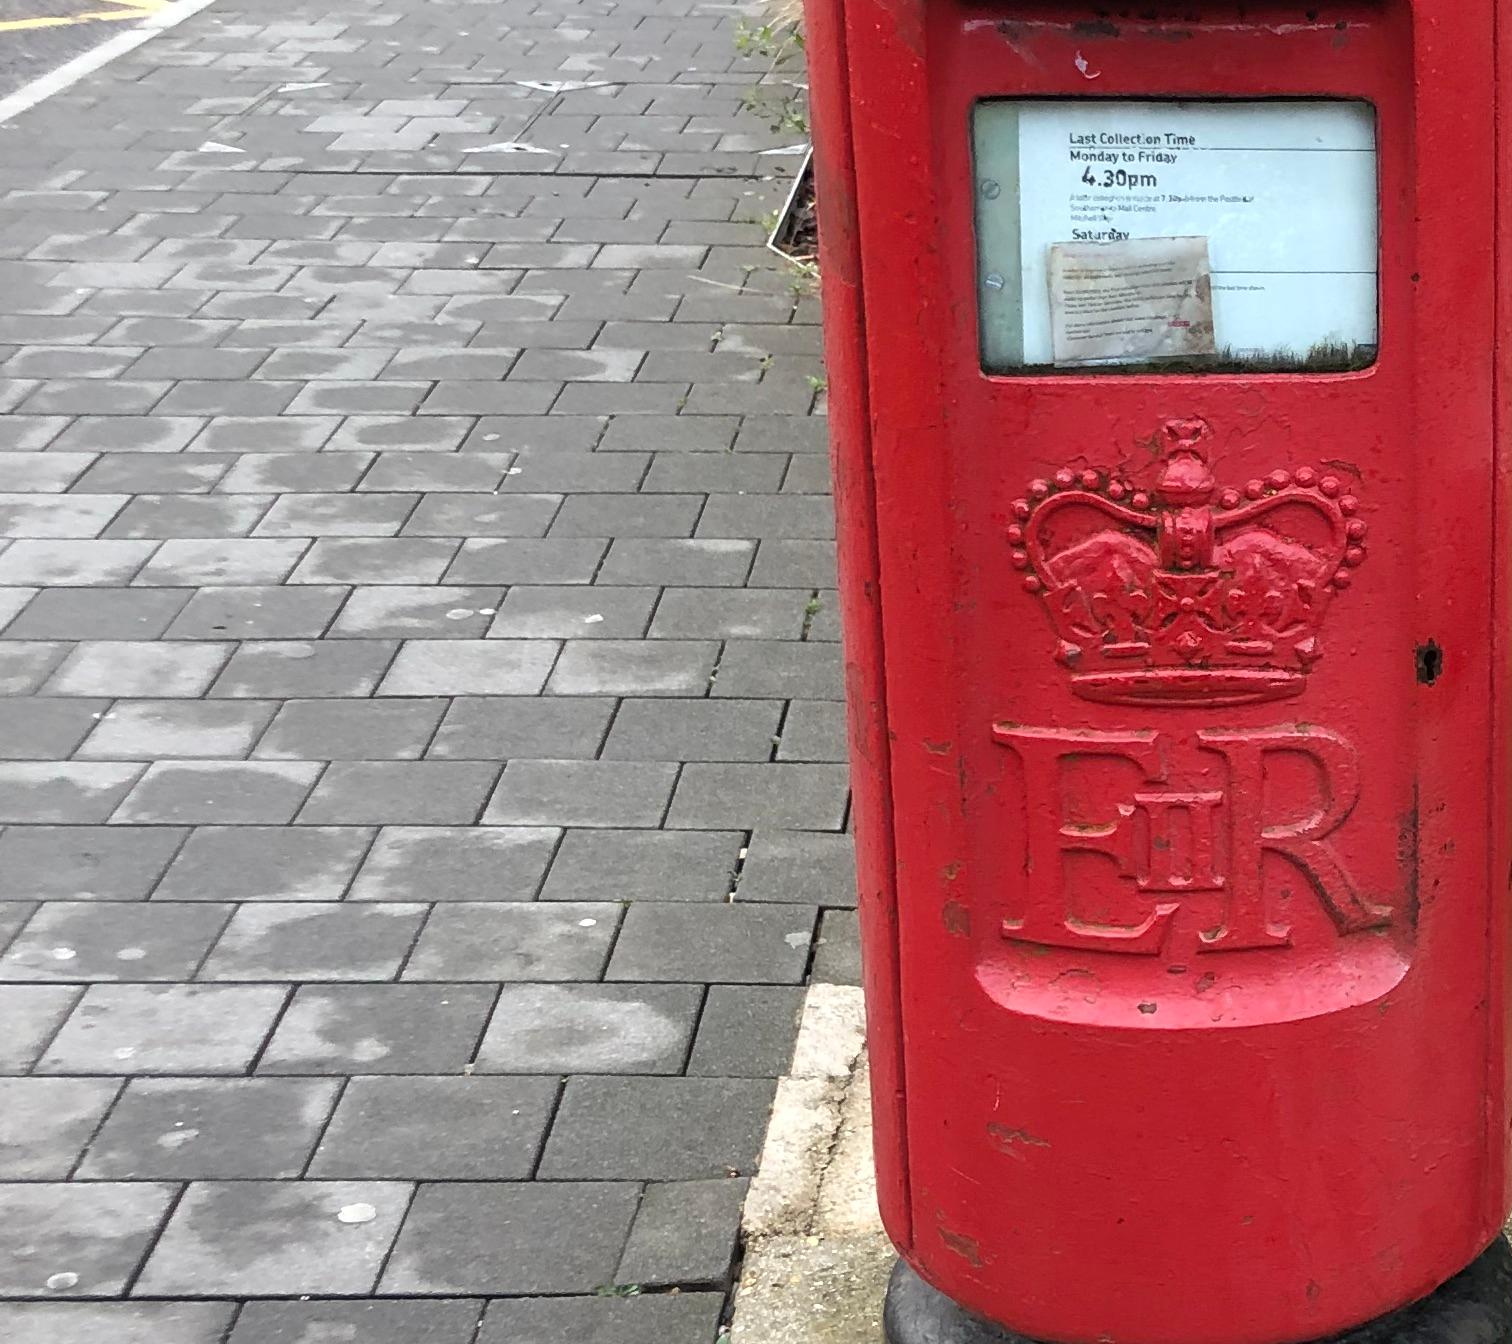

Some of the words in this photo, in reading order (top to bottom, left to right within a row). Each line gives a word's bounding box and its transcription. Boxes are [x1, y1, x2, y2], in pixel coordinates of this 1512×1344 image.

[1070, 133, 1097, 145] Last
[1100, 133, 1161, 145] Collection
[1164, 133, 1196, 145] Time
[1070, 151, 1119, 164] Monday
[1122, 152, 1135, 163] to
[1138, 151, 1178, 164] Friday
[1082, 165, 1157, 190] 4.30pm
[1072, 227, 1130, 241] Saturday
